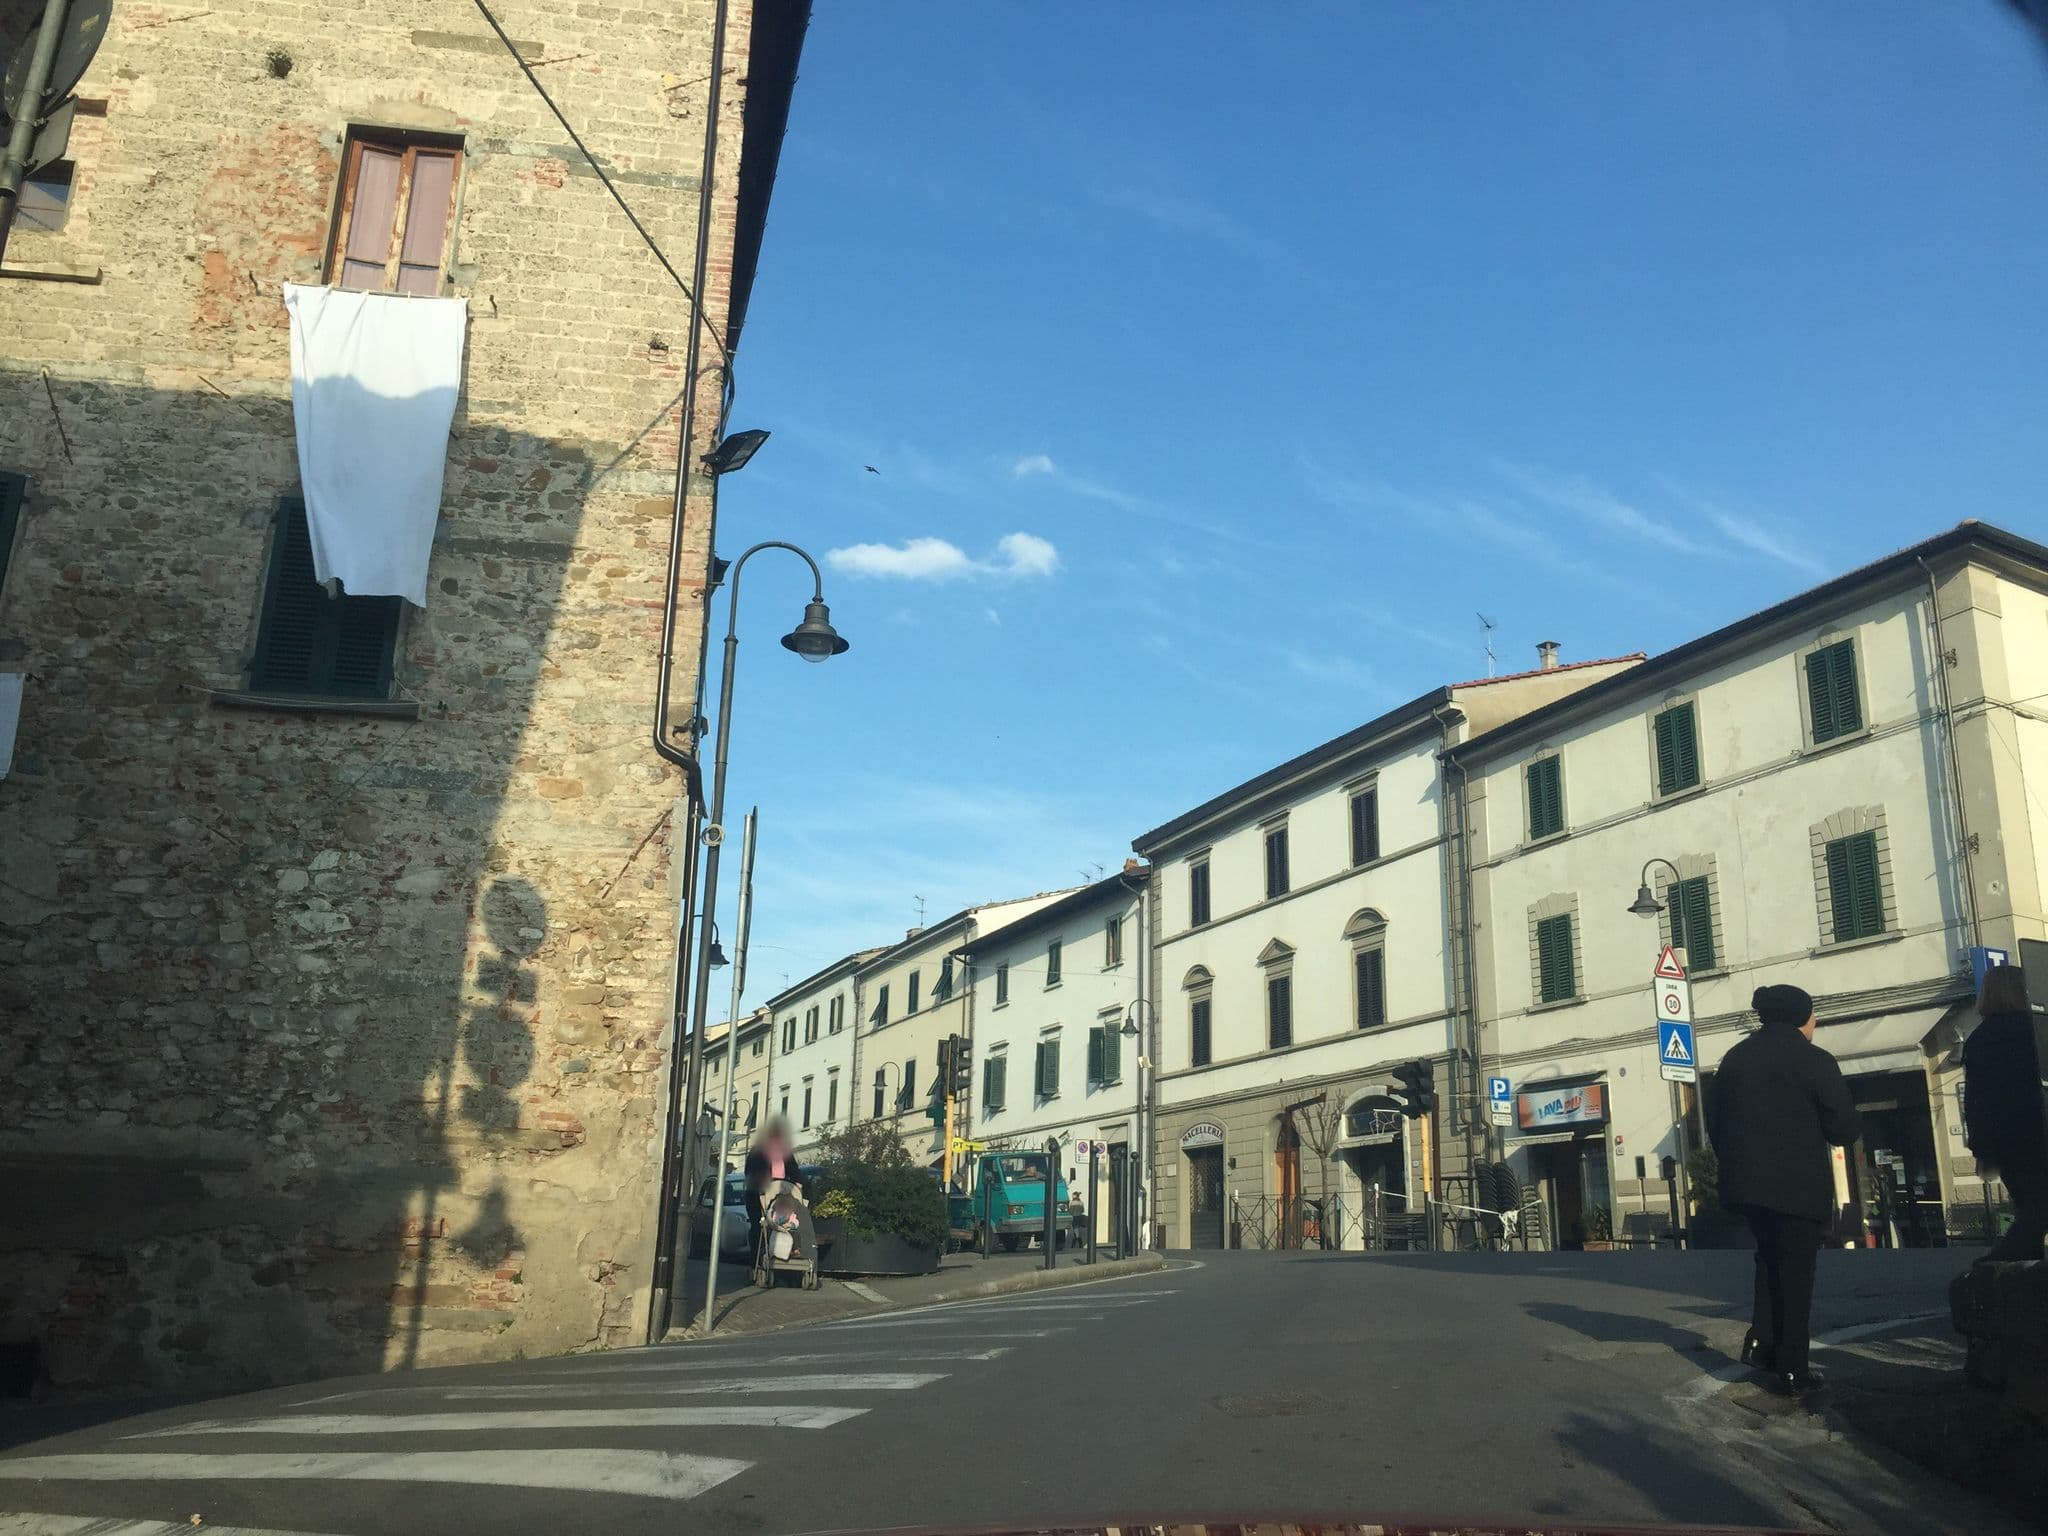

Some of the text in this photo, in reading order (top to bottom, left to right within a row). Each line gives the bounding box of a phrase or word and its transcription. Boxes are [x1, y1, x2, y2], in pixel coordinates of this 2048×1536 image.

[1493, 1079, 1506, 1099] P
[1538, 1098, 1563, 1119] LAVA
[1182, 1125, 1224, 1144] MACELLERIA
